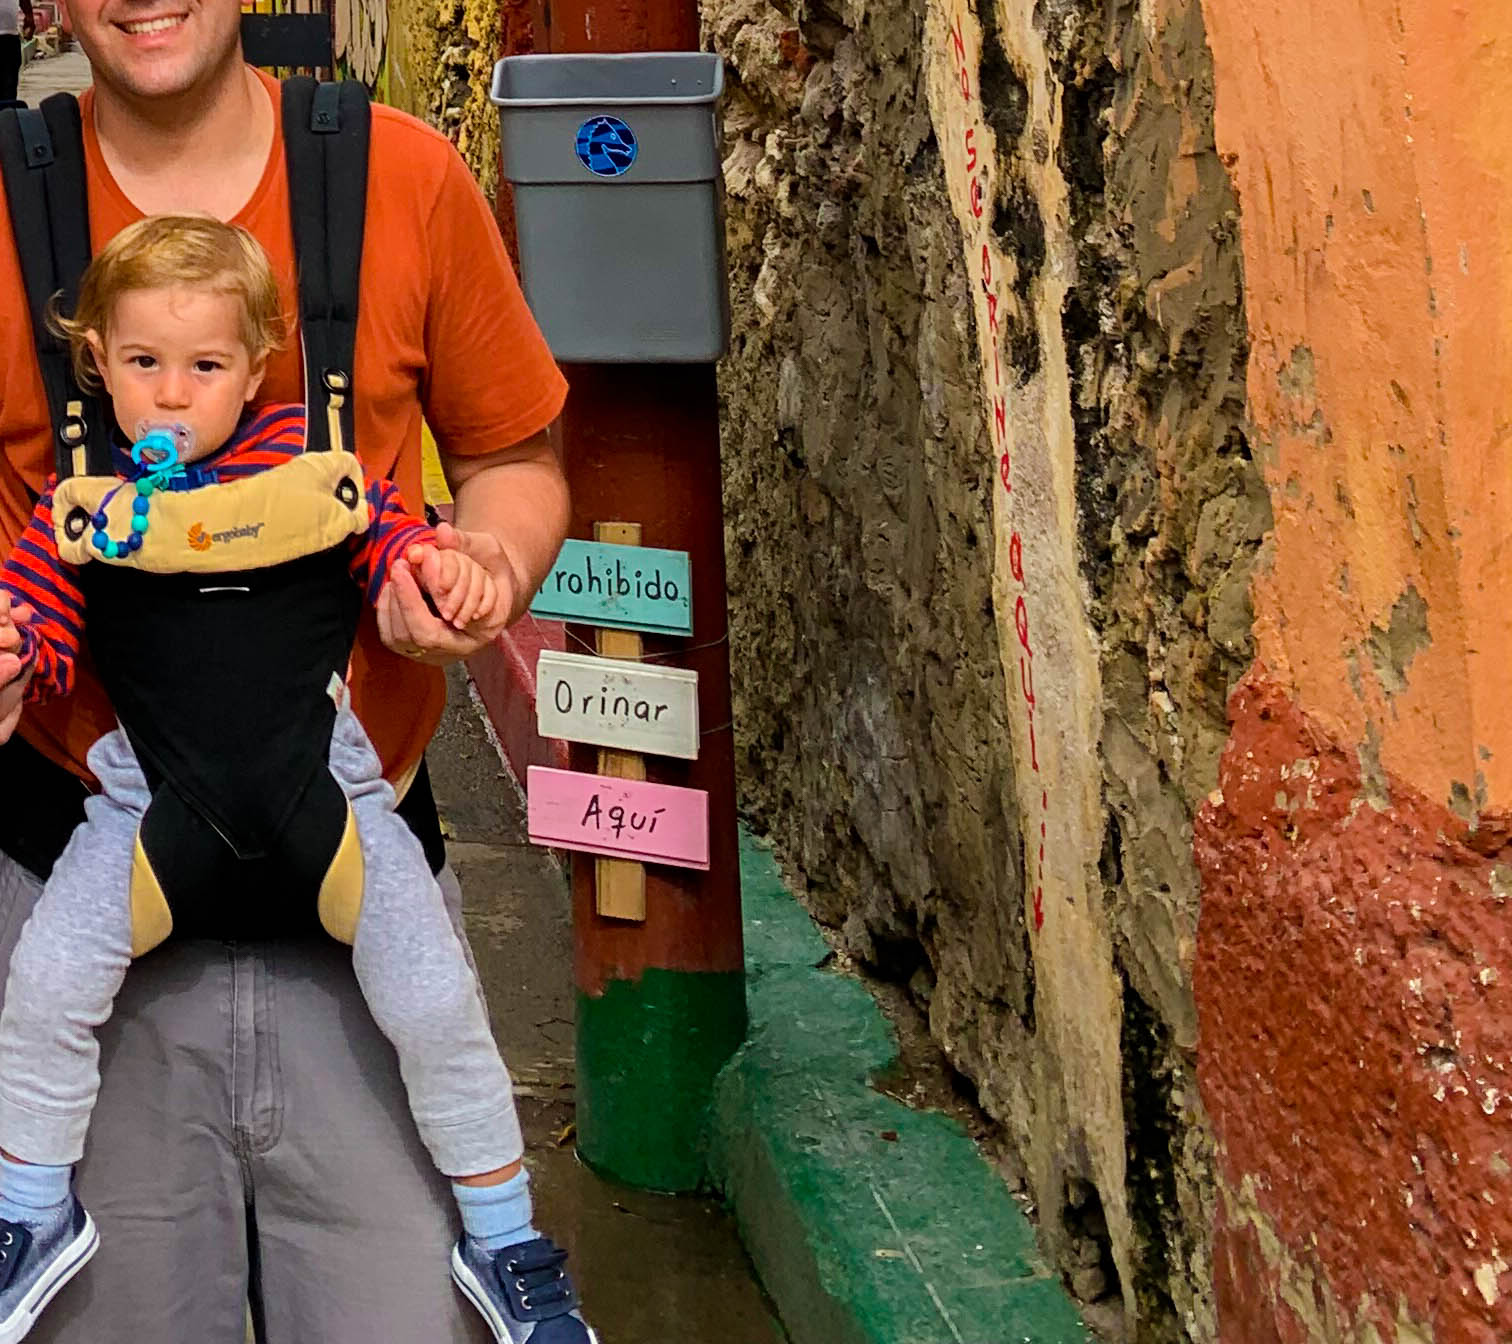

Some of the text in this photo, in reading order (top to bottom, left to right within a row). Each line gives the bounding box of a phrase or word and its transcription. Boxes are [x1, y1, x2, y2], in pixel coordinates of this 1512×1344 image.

[539, 556, 680, 602] rohibido
[554, 680, 669, 722] Orinar
[581, 793, 667, 838] Aquí
